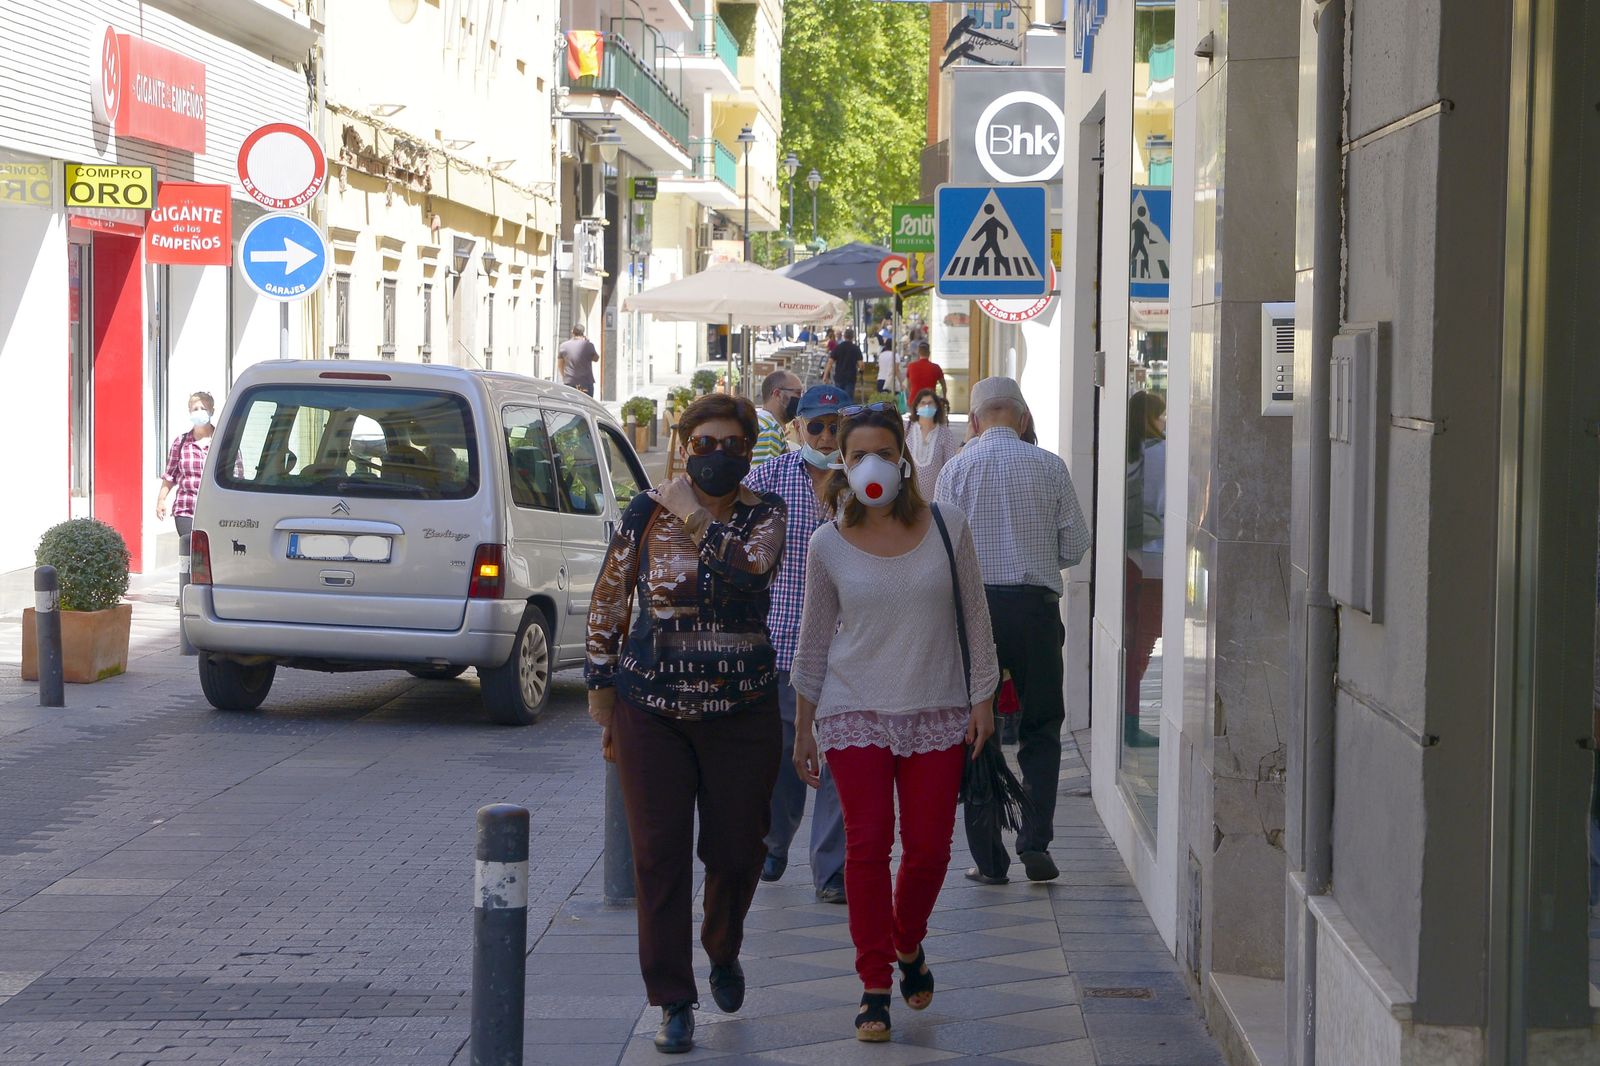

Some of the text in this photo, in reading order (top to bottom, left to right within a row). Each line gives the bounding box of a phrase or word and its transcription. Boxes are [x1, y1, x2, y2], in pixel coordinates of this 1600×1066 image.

[136, 73, 165, 109] GIGANTE
[171, 84, 204, 120] EMPEÑOS
[990, 125, 1057, 155] Bhk
[75, 167, 142, 179] COMPRO
[70, 182, 148, 205] ORO
[242, 178, 251, 191] DE
[252, 189, 275, 206] 12:00
[276, 200, 286, 208] H.
[288, 199, 296, 207] A
[296, 186, 317, 204] 01:00
[151, 206, 223, 224] GIGANTE
[173, 224, 201, 233] de los
[151, 234, 221, 251] EMPEÑOS
[265, 283, 306, 294] GARAJES
[987, 303, 1008, 319] 12:00
[1009, 312, 1019, 320] H.
[1027, 299, 1047, 316] 01:00
[422, 528, 470, 542] Berlingo
